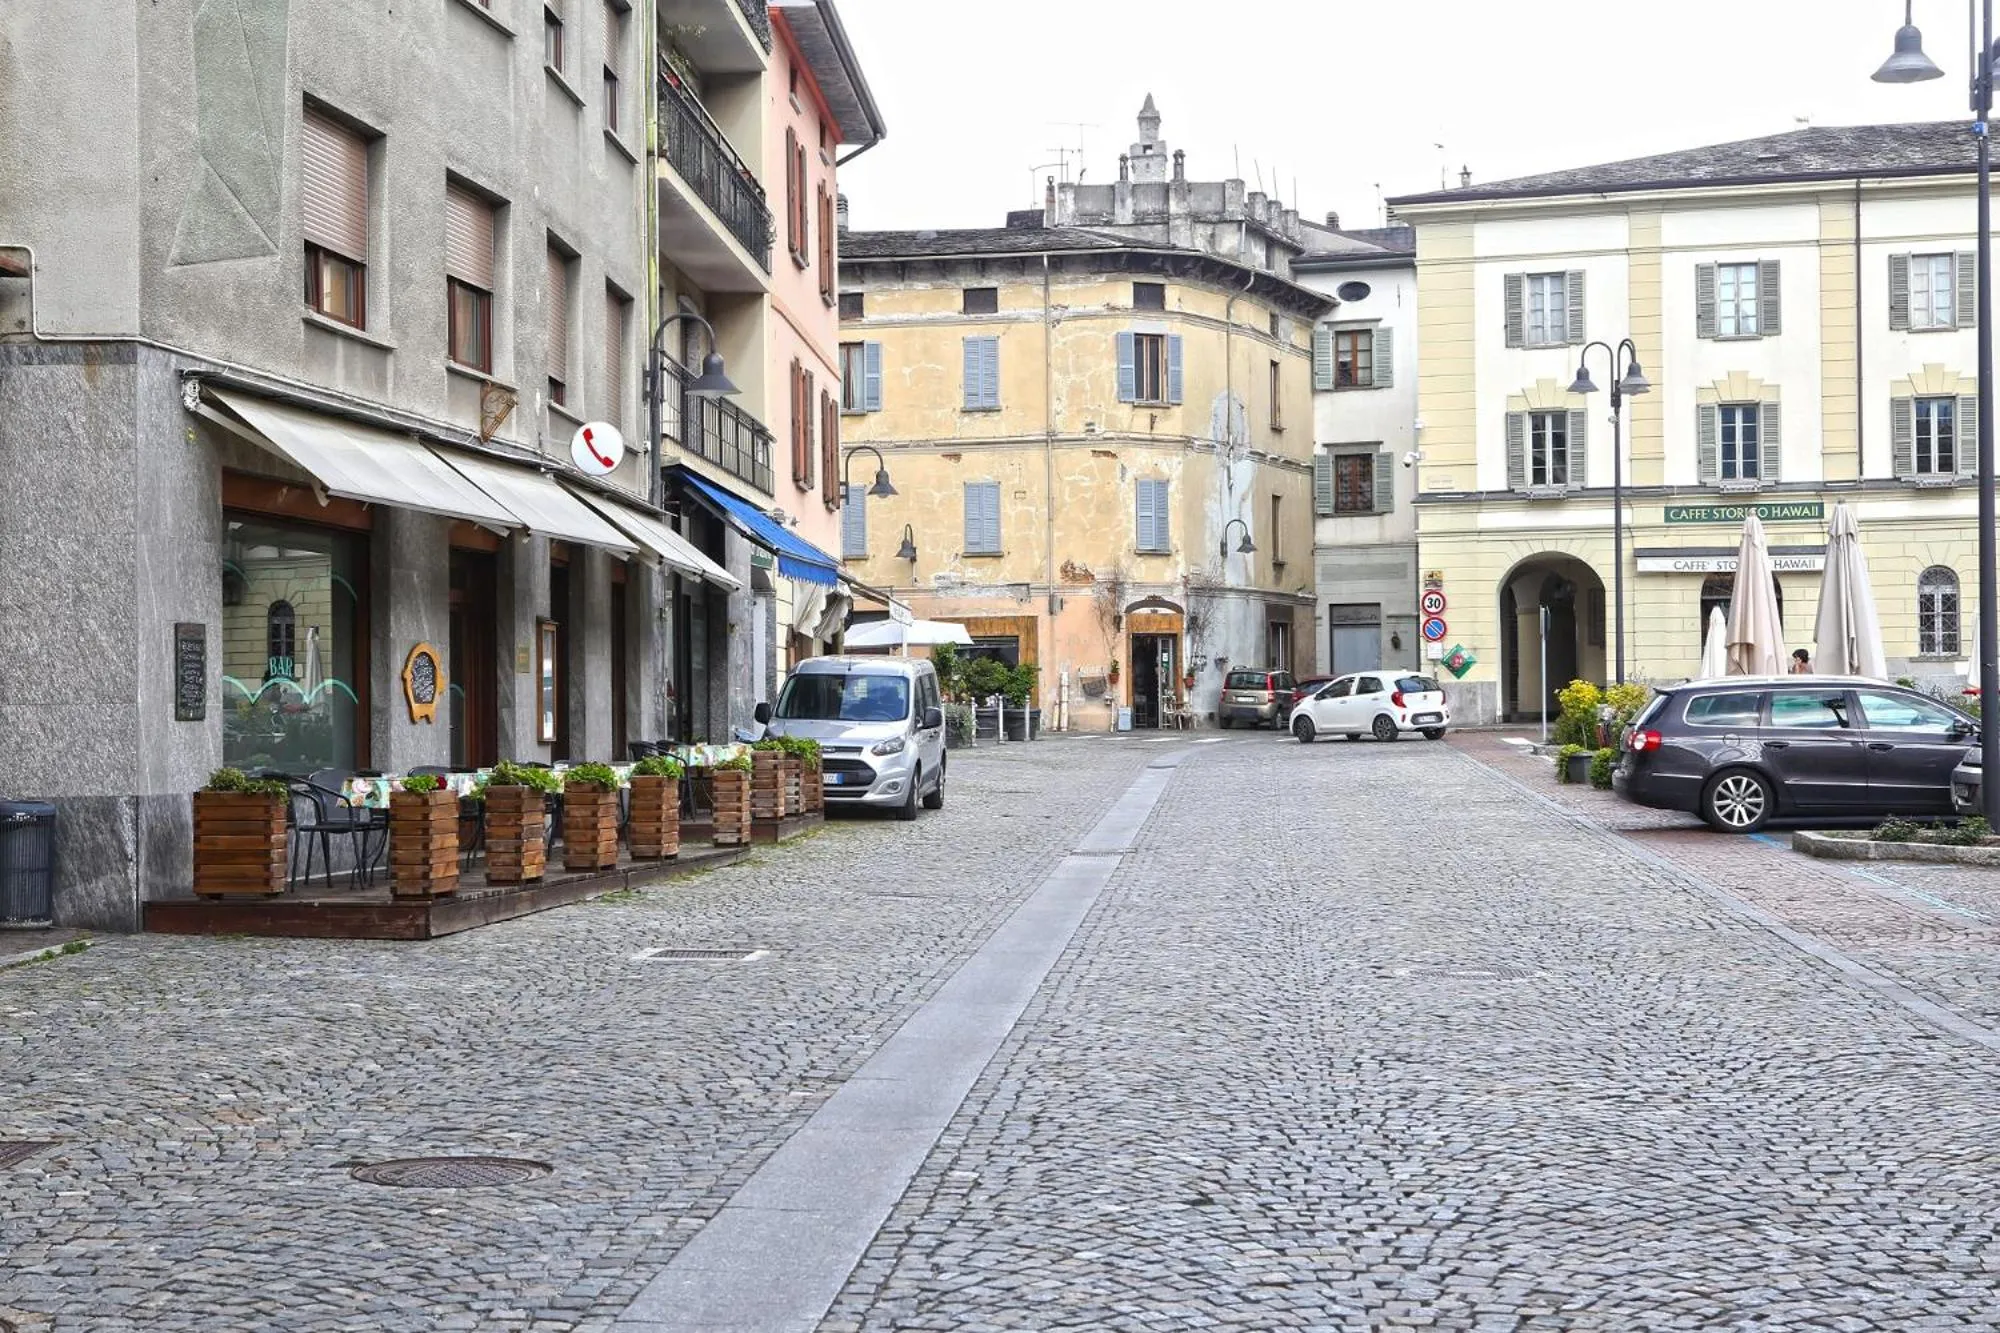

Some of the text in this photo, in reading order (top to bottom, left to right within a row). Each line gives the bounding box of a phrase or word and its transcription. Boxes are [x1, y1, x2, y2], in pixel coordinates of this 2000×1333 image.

[1670, 505, 1818, 520] CAFFE' STORIO HAWAII
[1716, 560, 1738, 570] STO
[1774, 559, 1816, 569] HAWAII
[1426, 597, 1441, 609] 30
[269, 656, 293, 677] BAR
